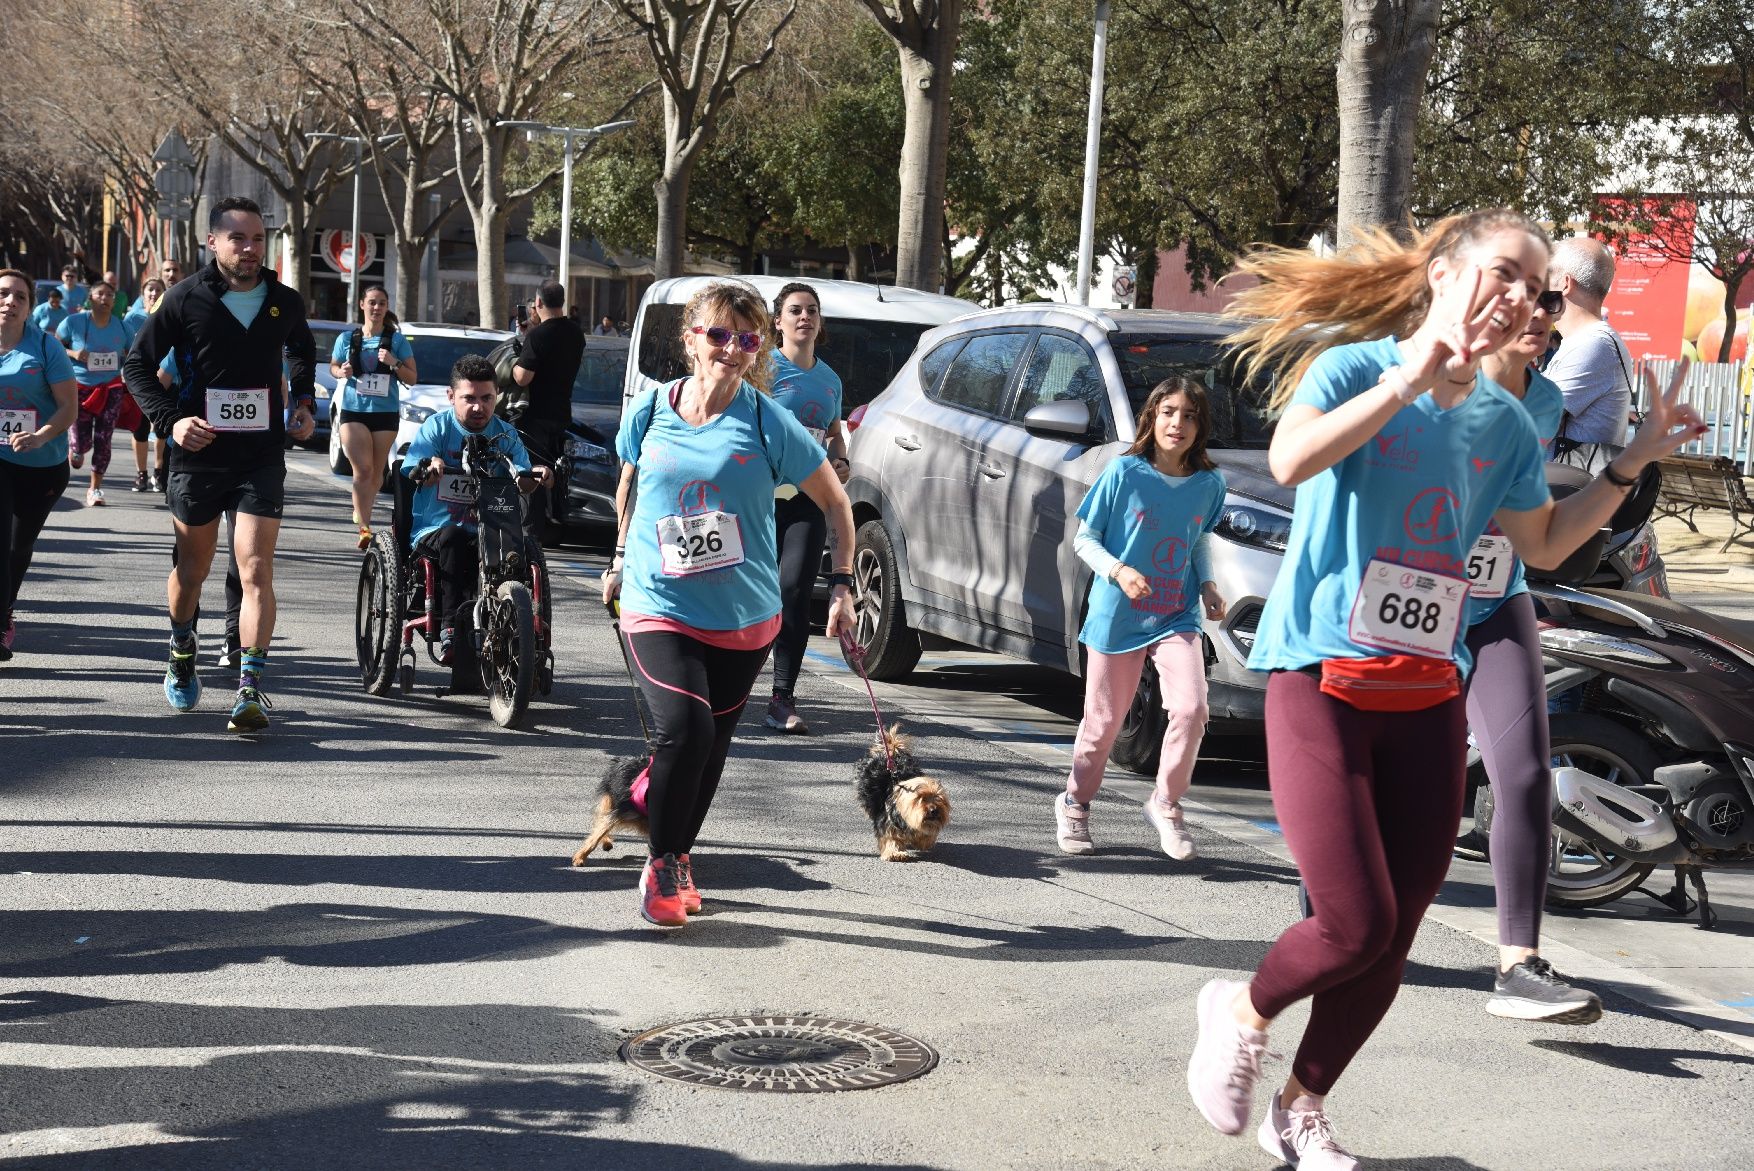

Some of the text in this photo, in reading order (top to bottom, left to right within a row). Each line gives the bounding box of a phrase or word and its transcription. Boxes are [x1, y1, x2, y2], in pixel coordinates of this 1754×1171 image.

[94, 358, 112, 366] 314
[367, 380, 378, 389] 11
[219, 403, 257, 420] 589
[676, 530, 723, 558] 326
[1379, 592, 1441, 634] 688
